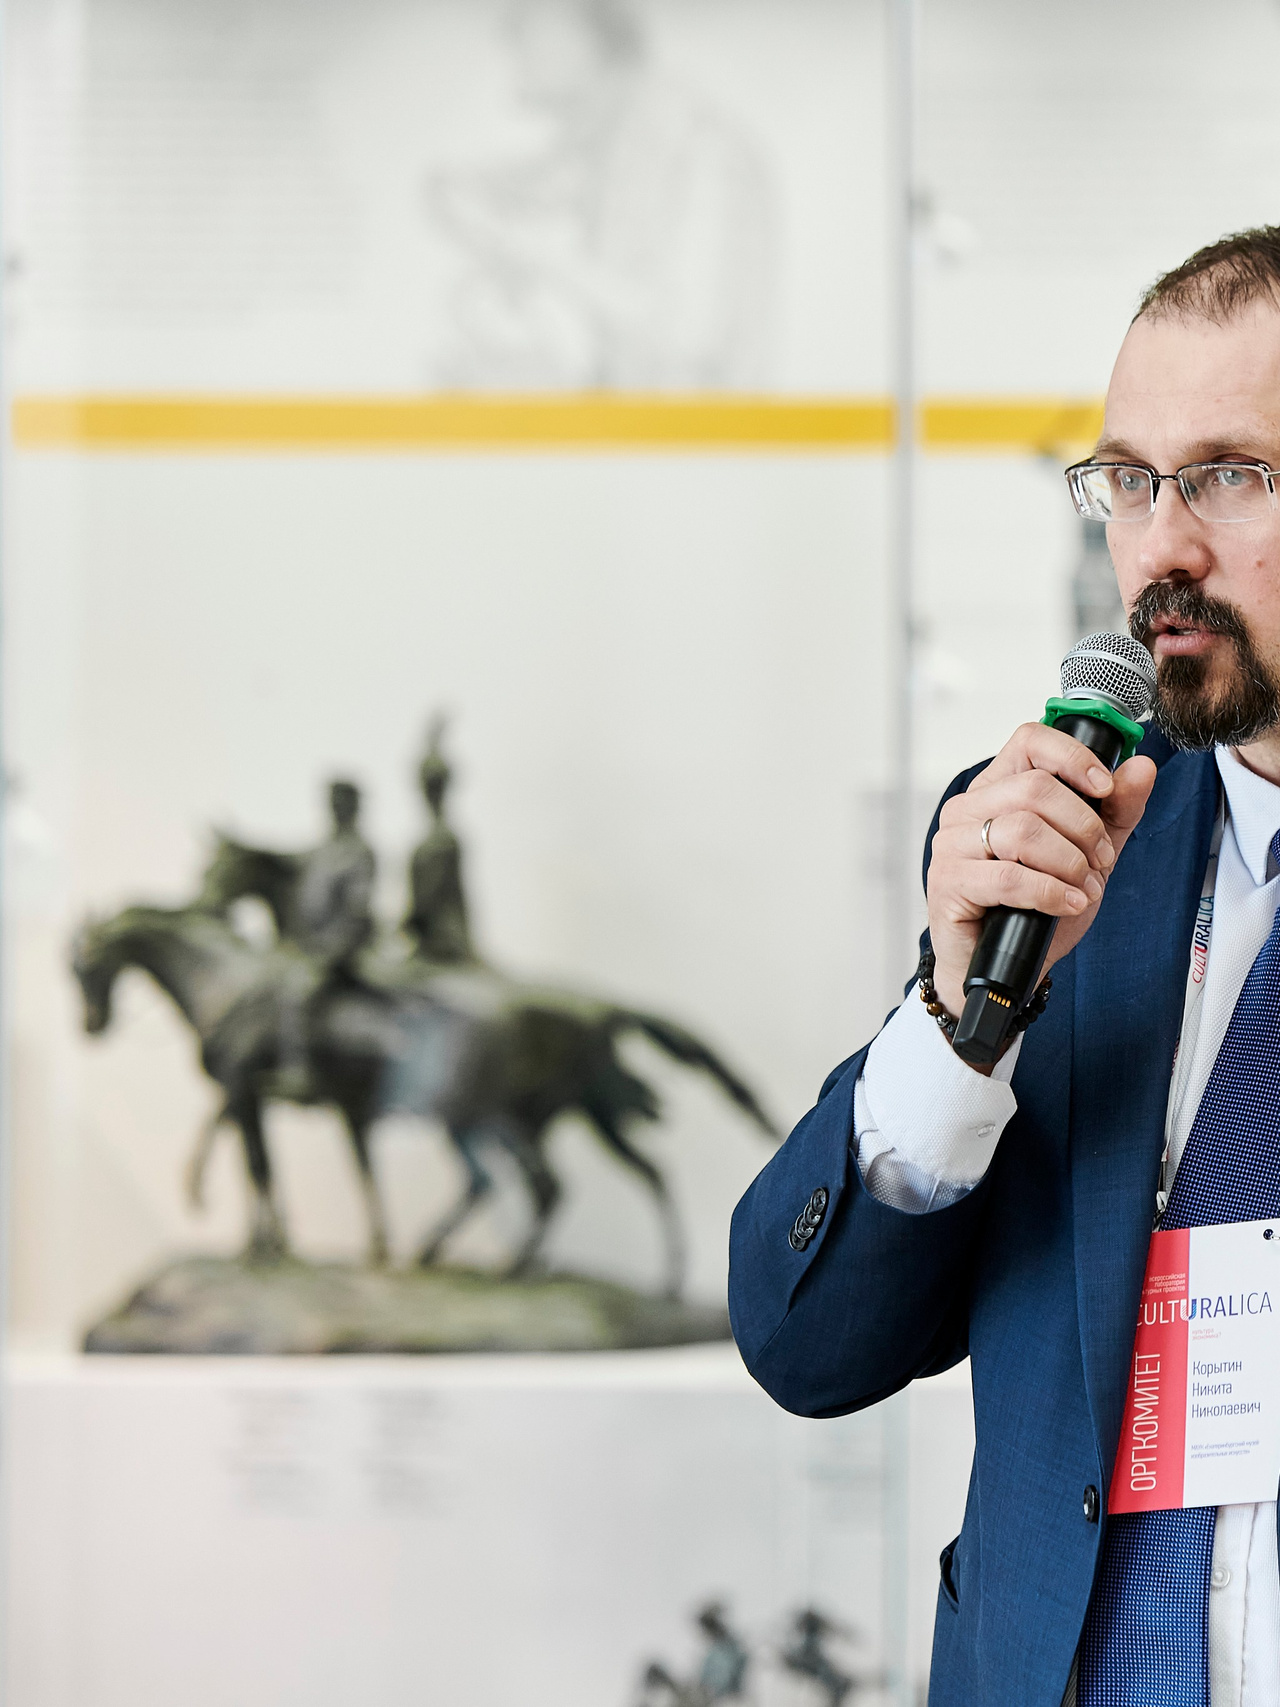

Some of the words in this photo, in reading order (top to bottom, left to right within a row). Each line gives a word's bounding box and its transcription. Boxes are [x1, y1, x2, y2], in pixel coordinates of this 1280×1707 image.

[1192, 895, 1215, 984] CULTURALICA
[1192, 1360, 1243, 1378] Корытин
[1192, 1382, 1233, 1397] Никита
[1191, 1402, 1261, 1418] Николаевич
[1130, 1351, 1161, 1491] ОРГКОМИТЕТ
